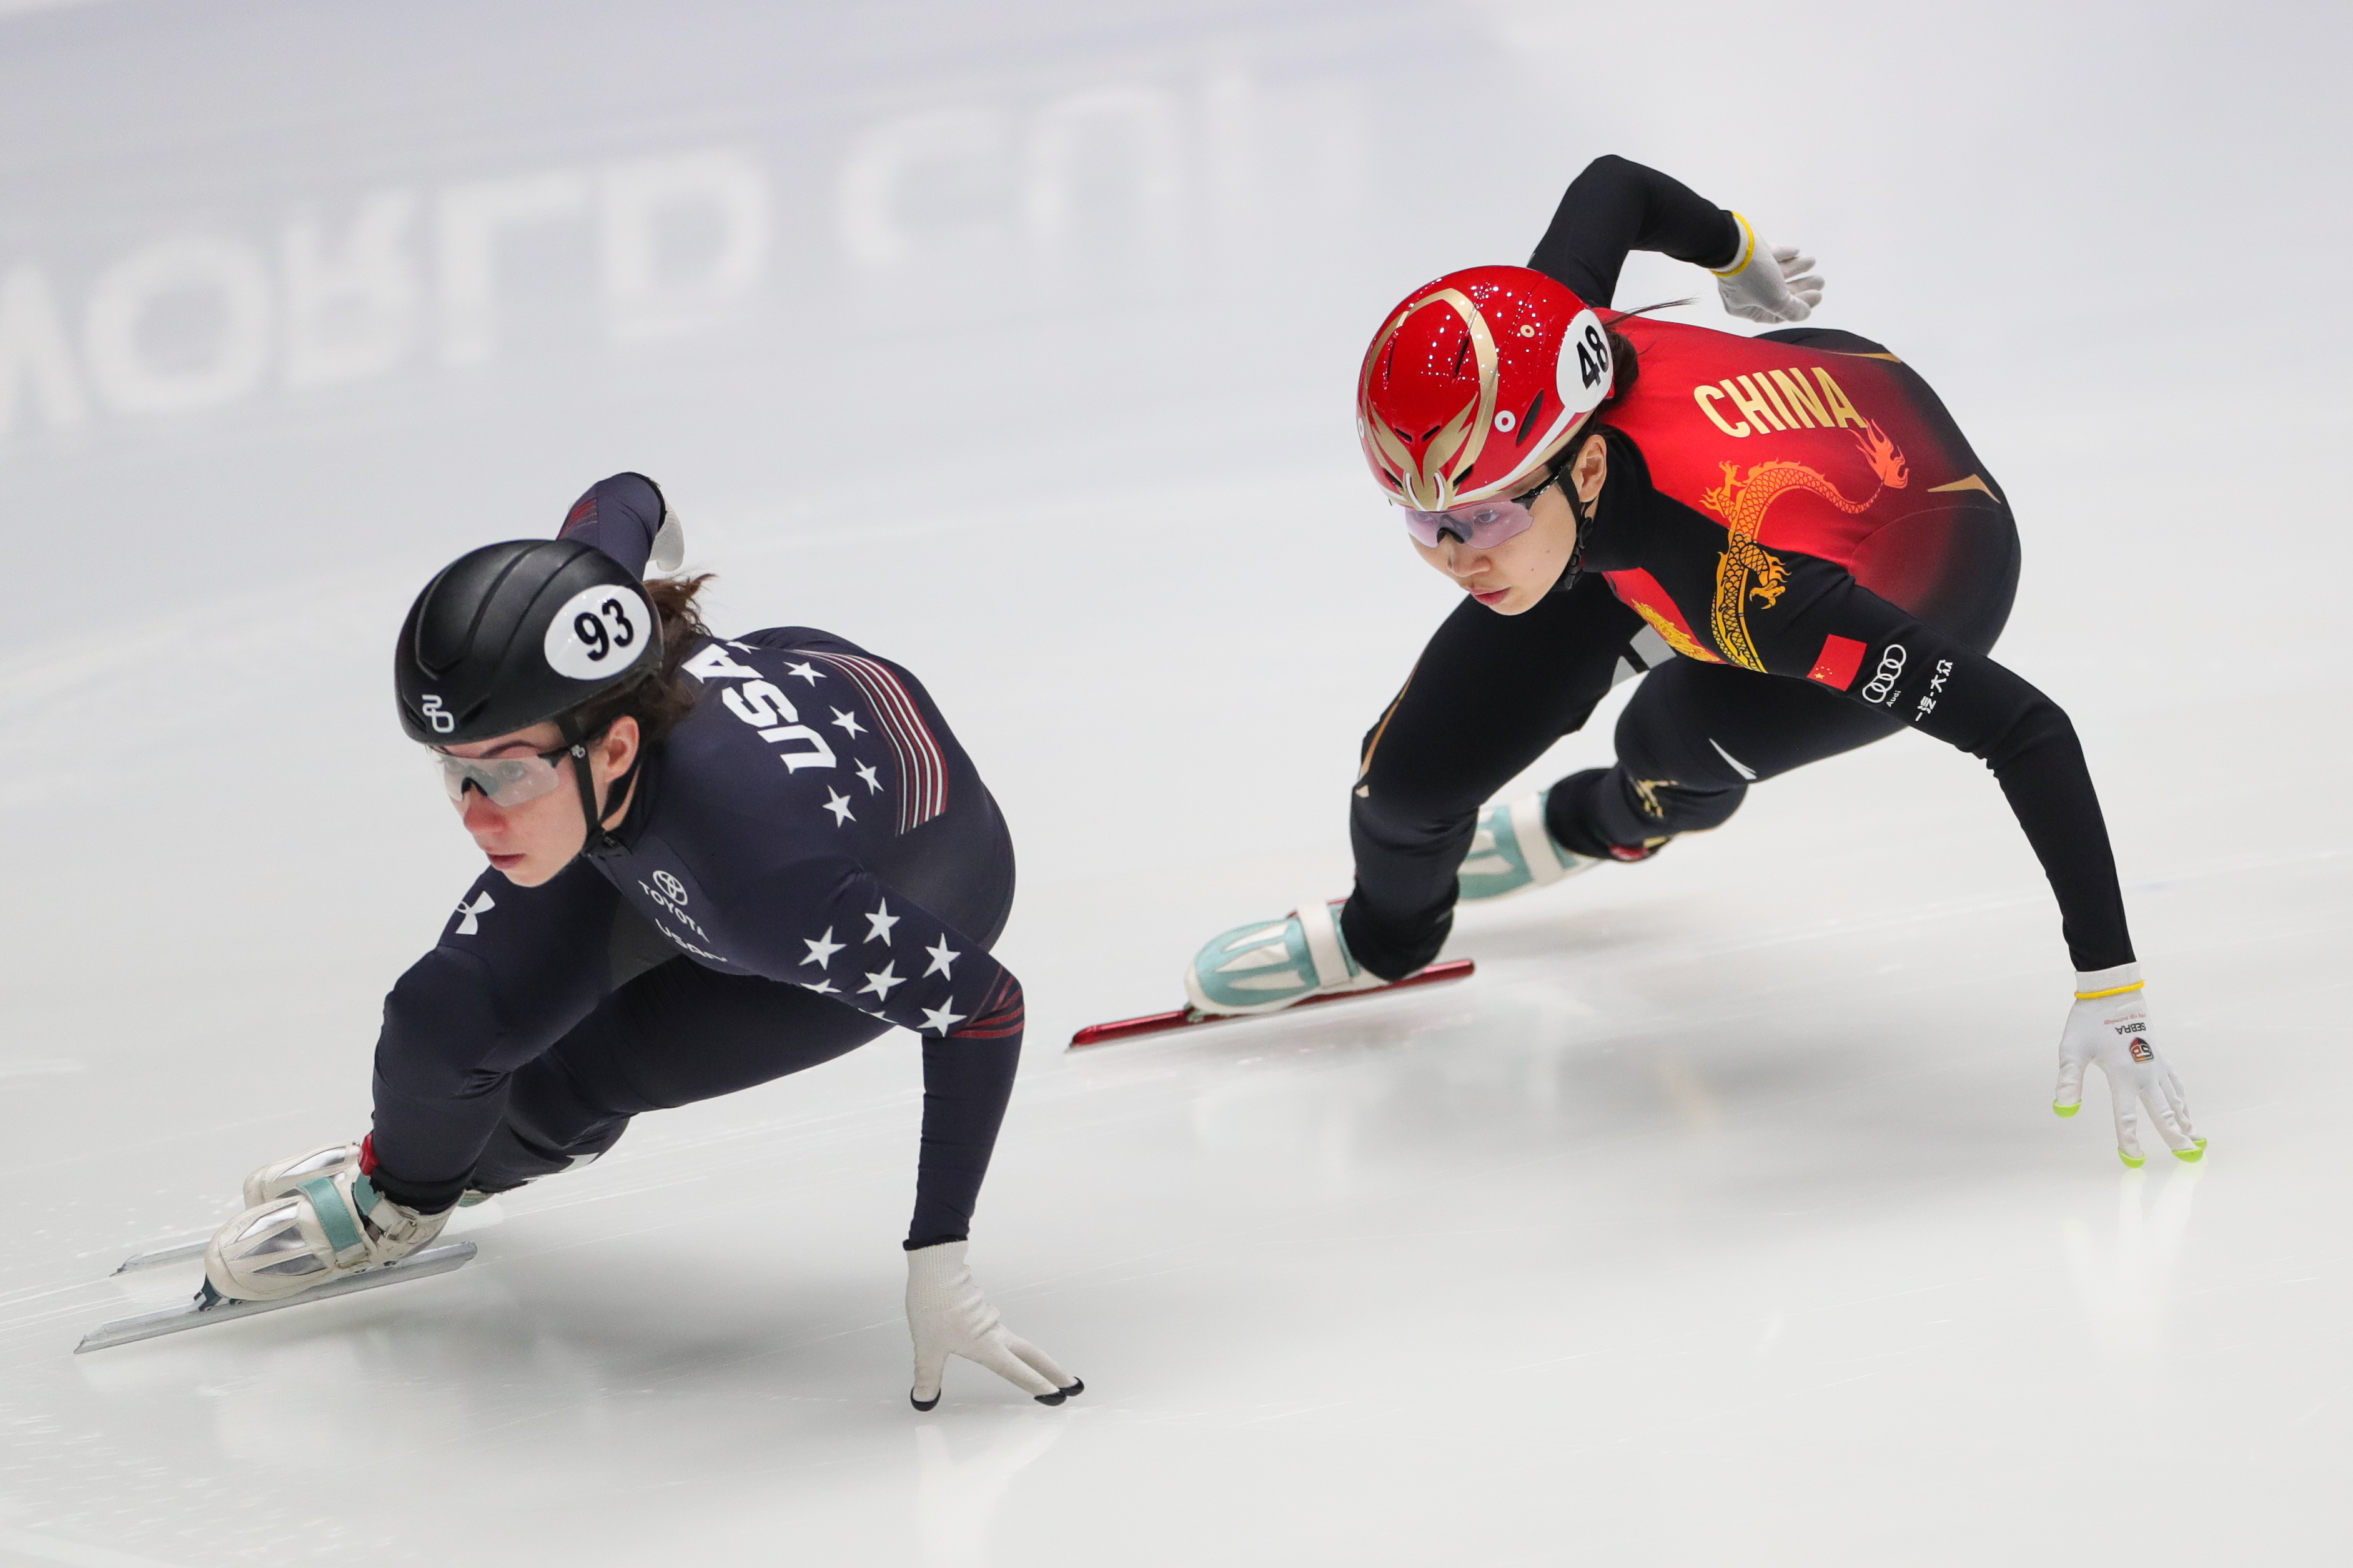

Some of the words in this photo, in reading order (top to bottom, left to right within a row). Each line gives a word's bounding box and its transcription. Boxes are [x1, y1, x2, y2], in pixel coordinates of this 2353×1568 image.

[1576, 325, 1609, 390] 48
[1693, 367, 1868, 438] CHINA
[573, 598, 634, 661] 93
[681, 643, 837, 775] USA
[1886, 690, 1902, 708] Audi
[638, 879, 710, 944] TOYOTA
[2114, 1022, 2147, 1035] SEBRA
